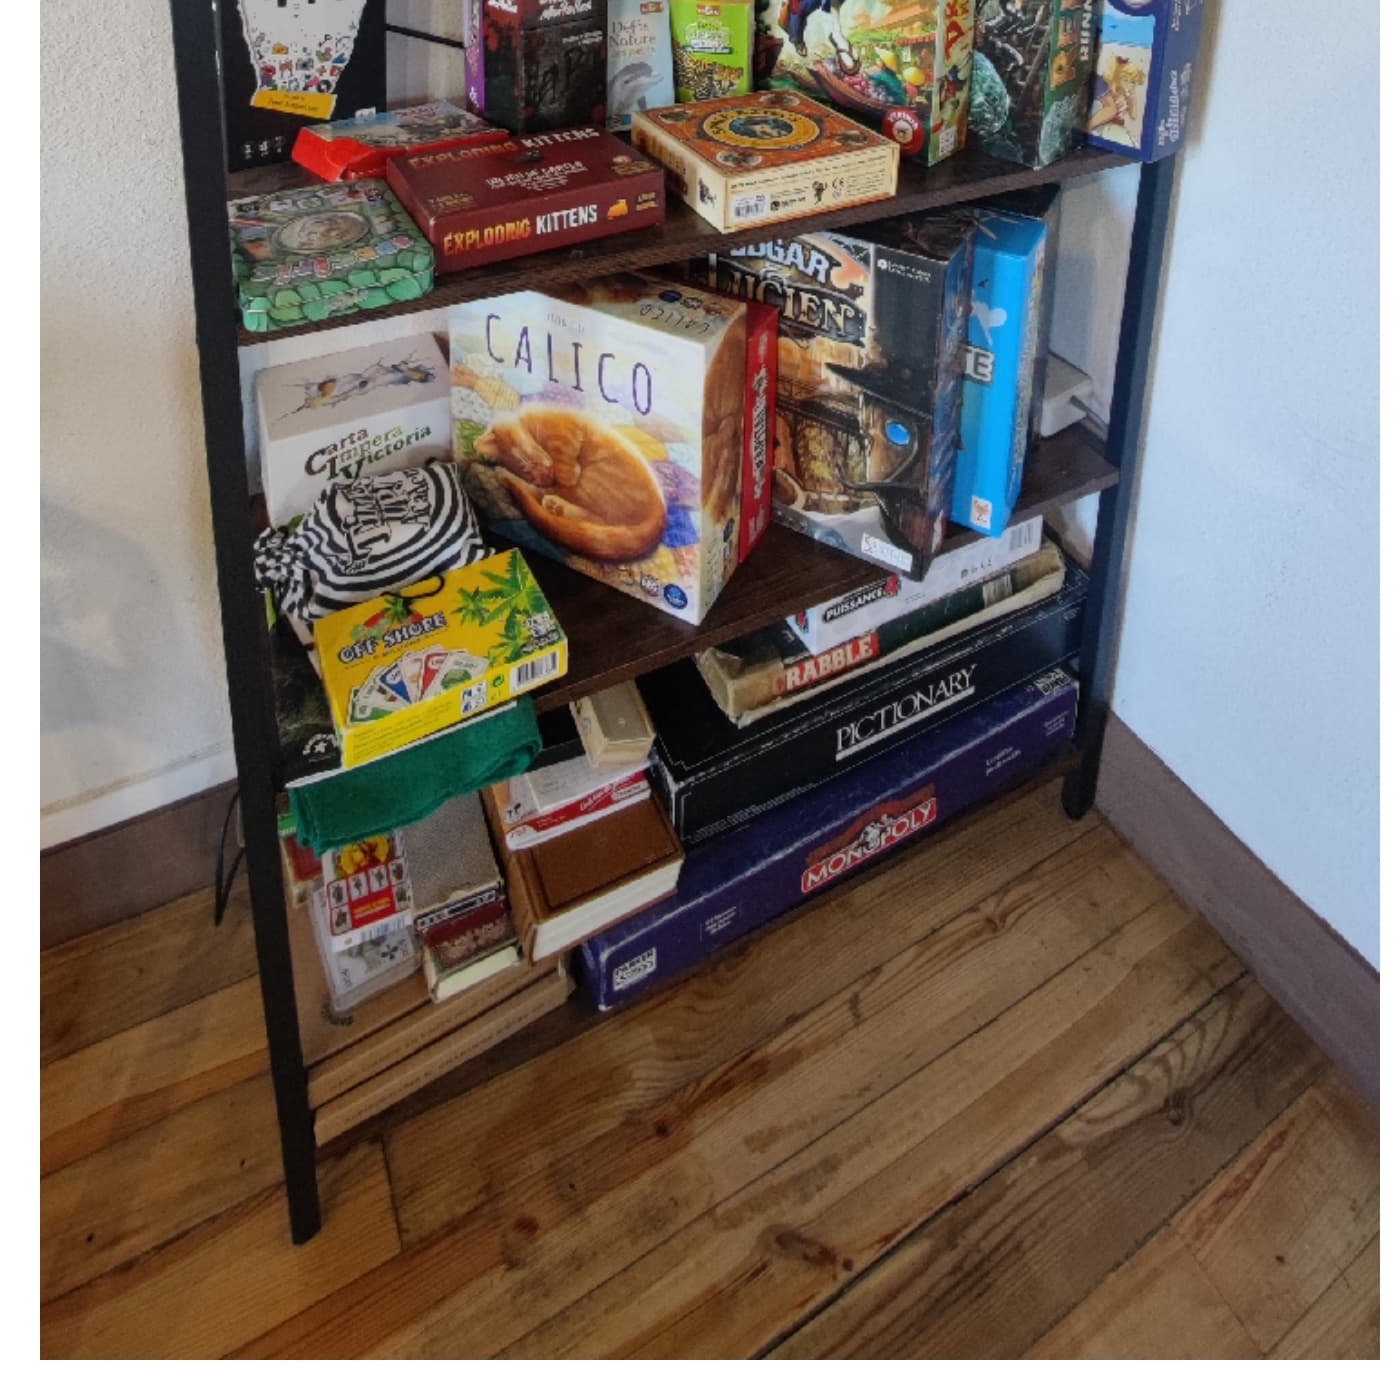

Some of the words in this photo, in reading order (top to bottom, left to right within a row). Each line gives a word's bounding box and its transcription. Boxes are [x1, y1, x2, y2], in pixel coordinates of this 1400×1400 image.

[443, 218, 532, 256] EXPLODING
[536, 204, 598, 235] KITTENS
[486, 313, 652, 416] CALICO
[825, 585, 884, 622] PUISSANCE
[884, 573, 899, 597] 4
[338, 638, 379, 665] OFF
[383, 612, 448, 649] SHORE
[835, 663, 978, 750] PICTIONARY
[805, 801, 934, 886] MONOPOLY
